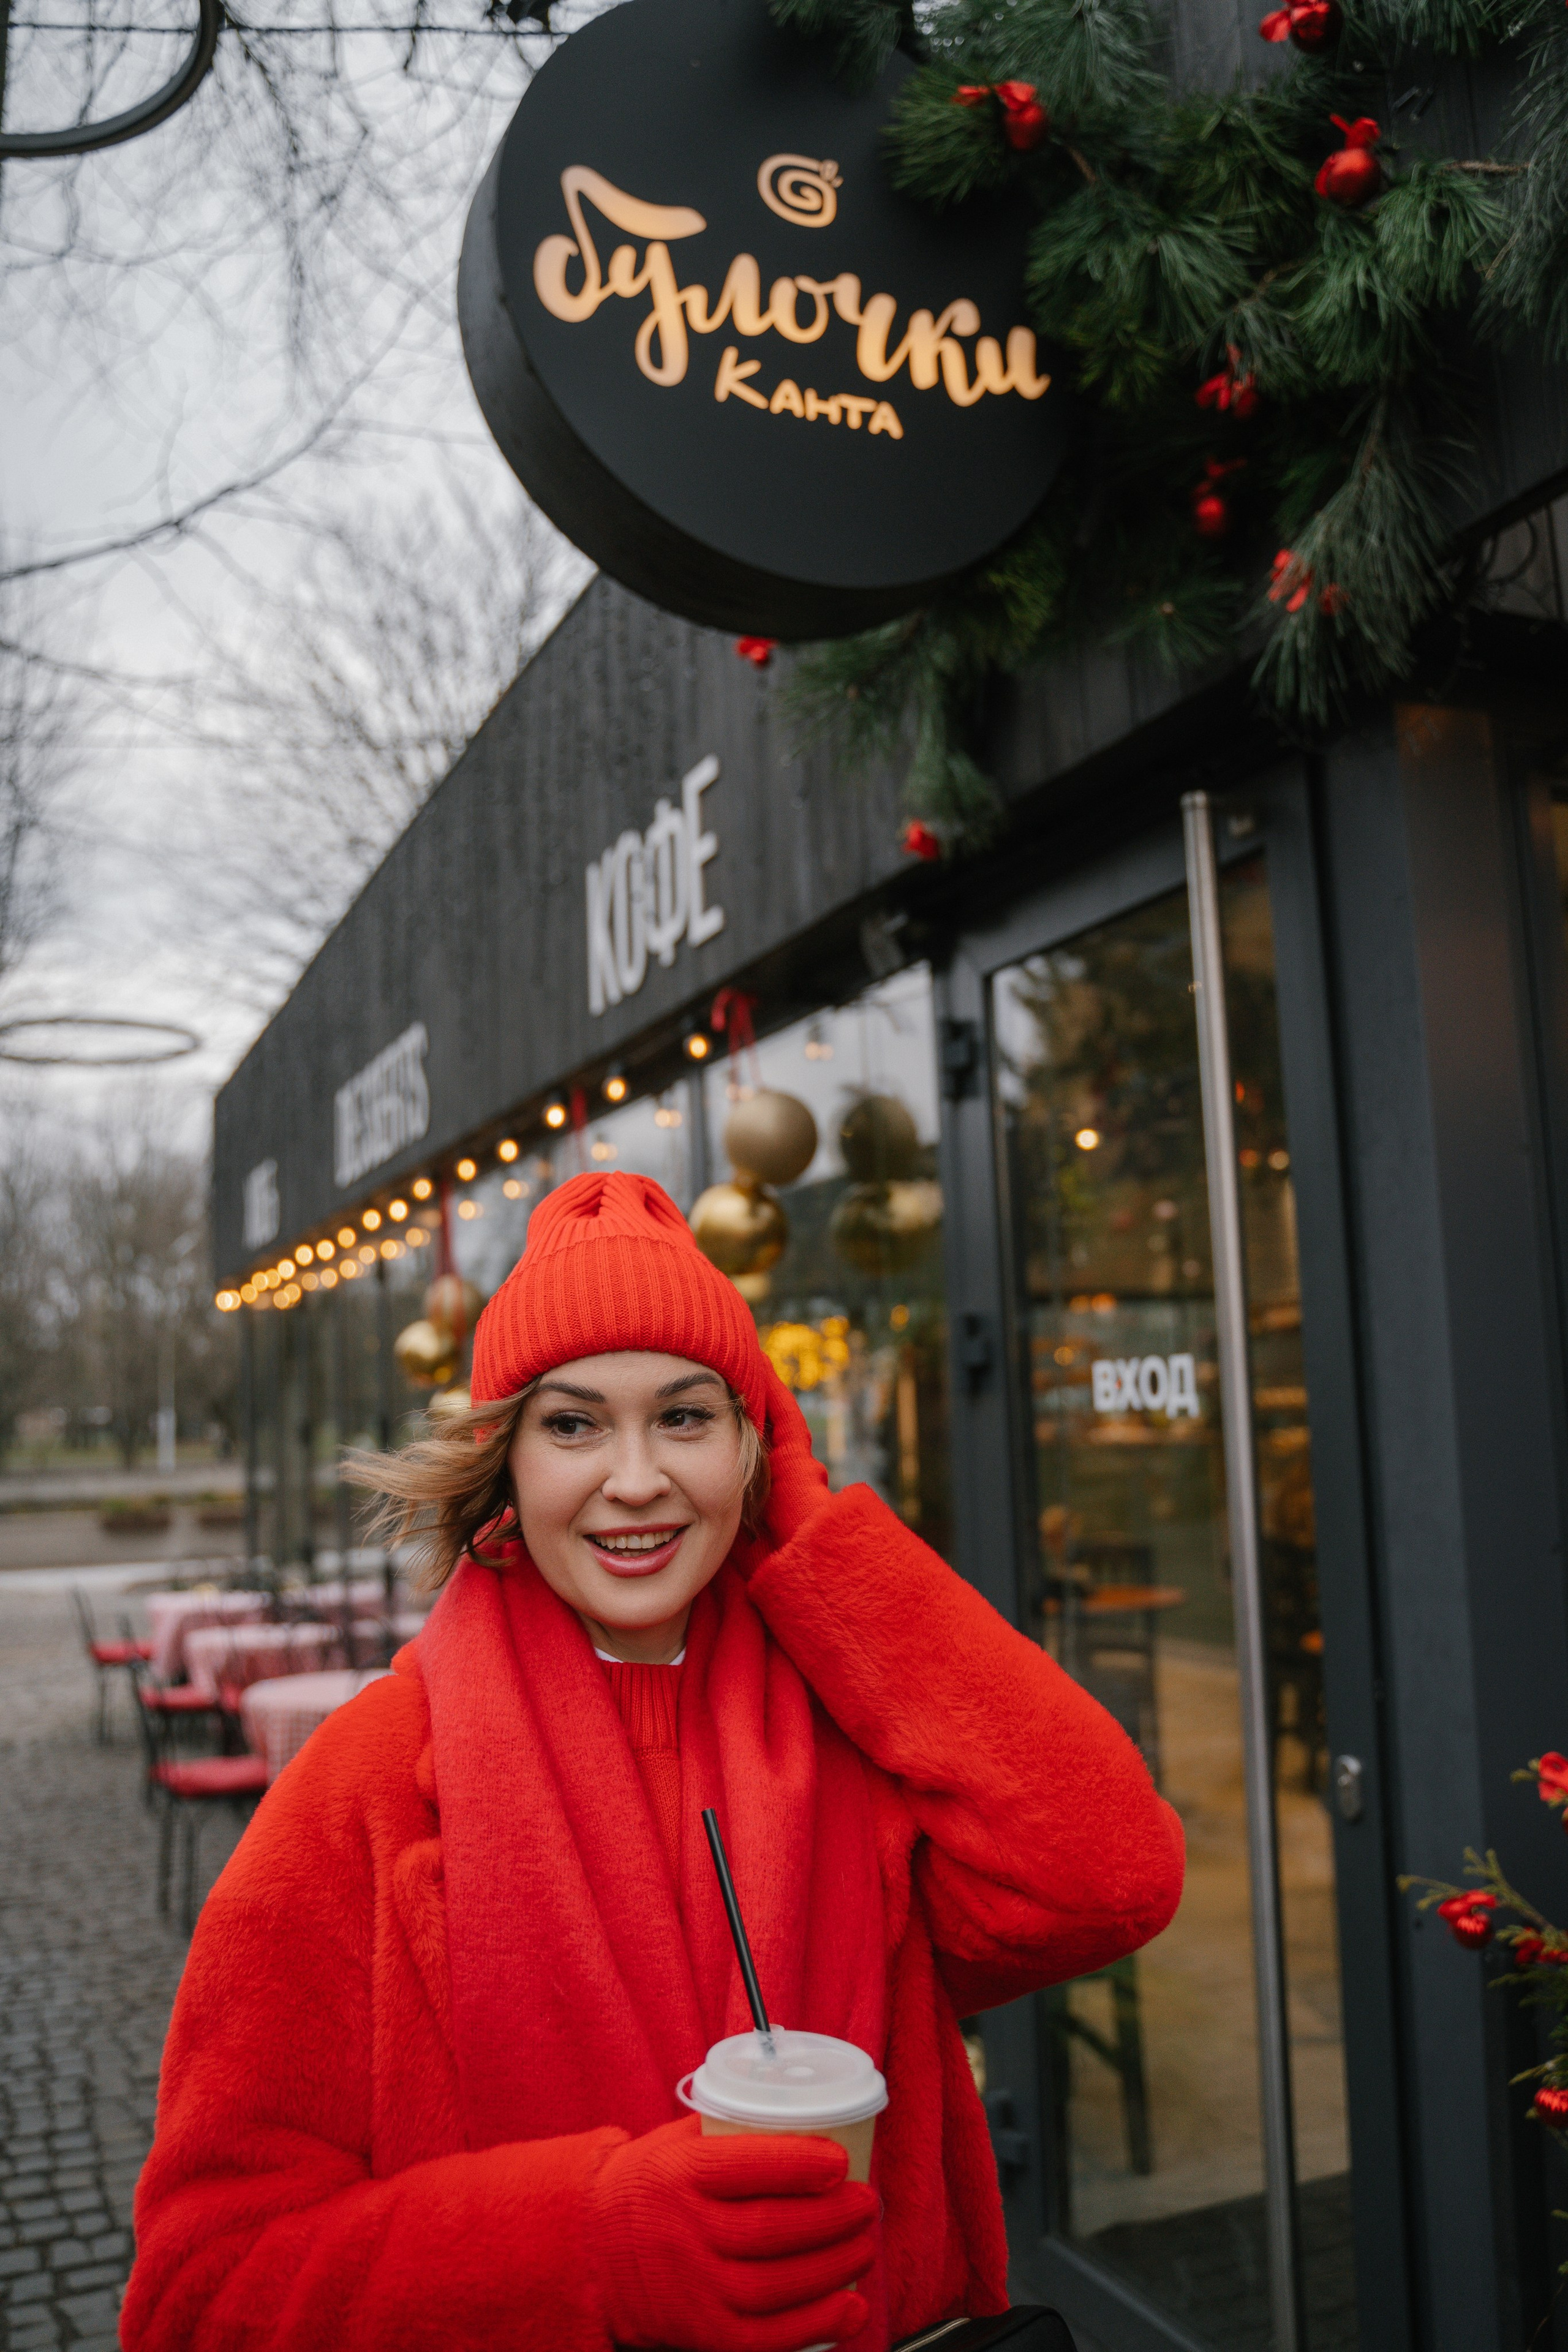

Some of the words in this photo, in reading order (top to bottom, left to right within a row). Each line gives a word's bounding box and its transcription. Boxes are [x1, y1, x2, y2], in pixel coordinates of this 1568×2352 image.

[714, 346, 904, 439] КАНТА
[586, 755, 724, 1016] КОФЕ
[1092, 1353, 1199, 1417] ВХОД
